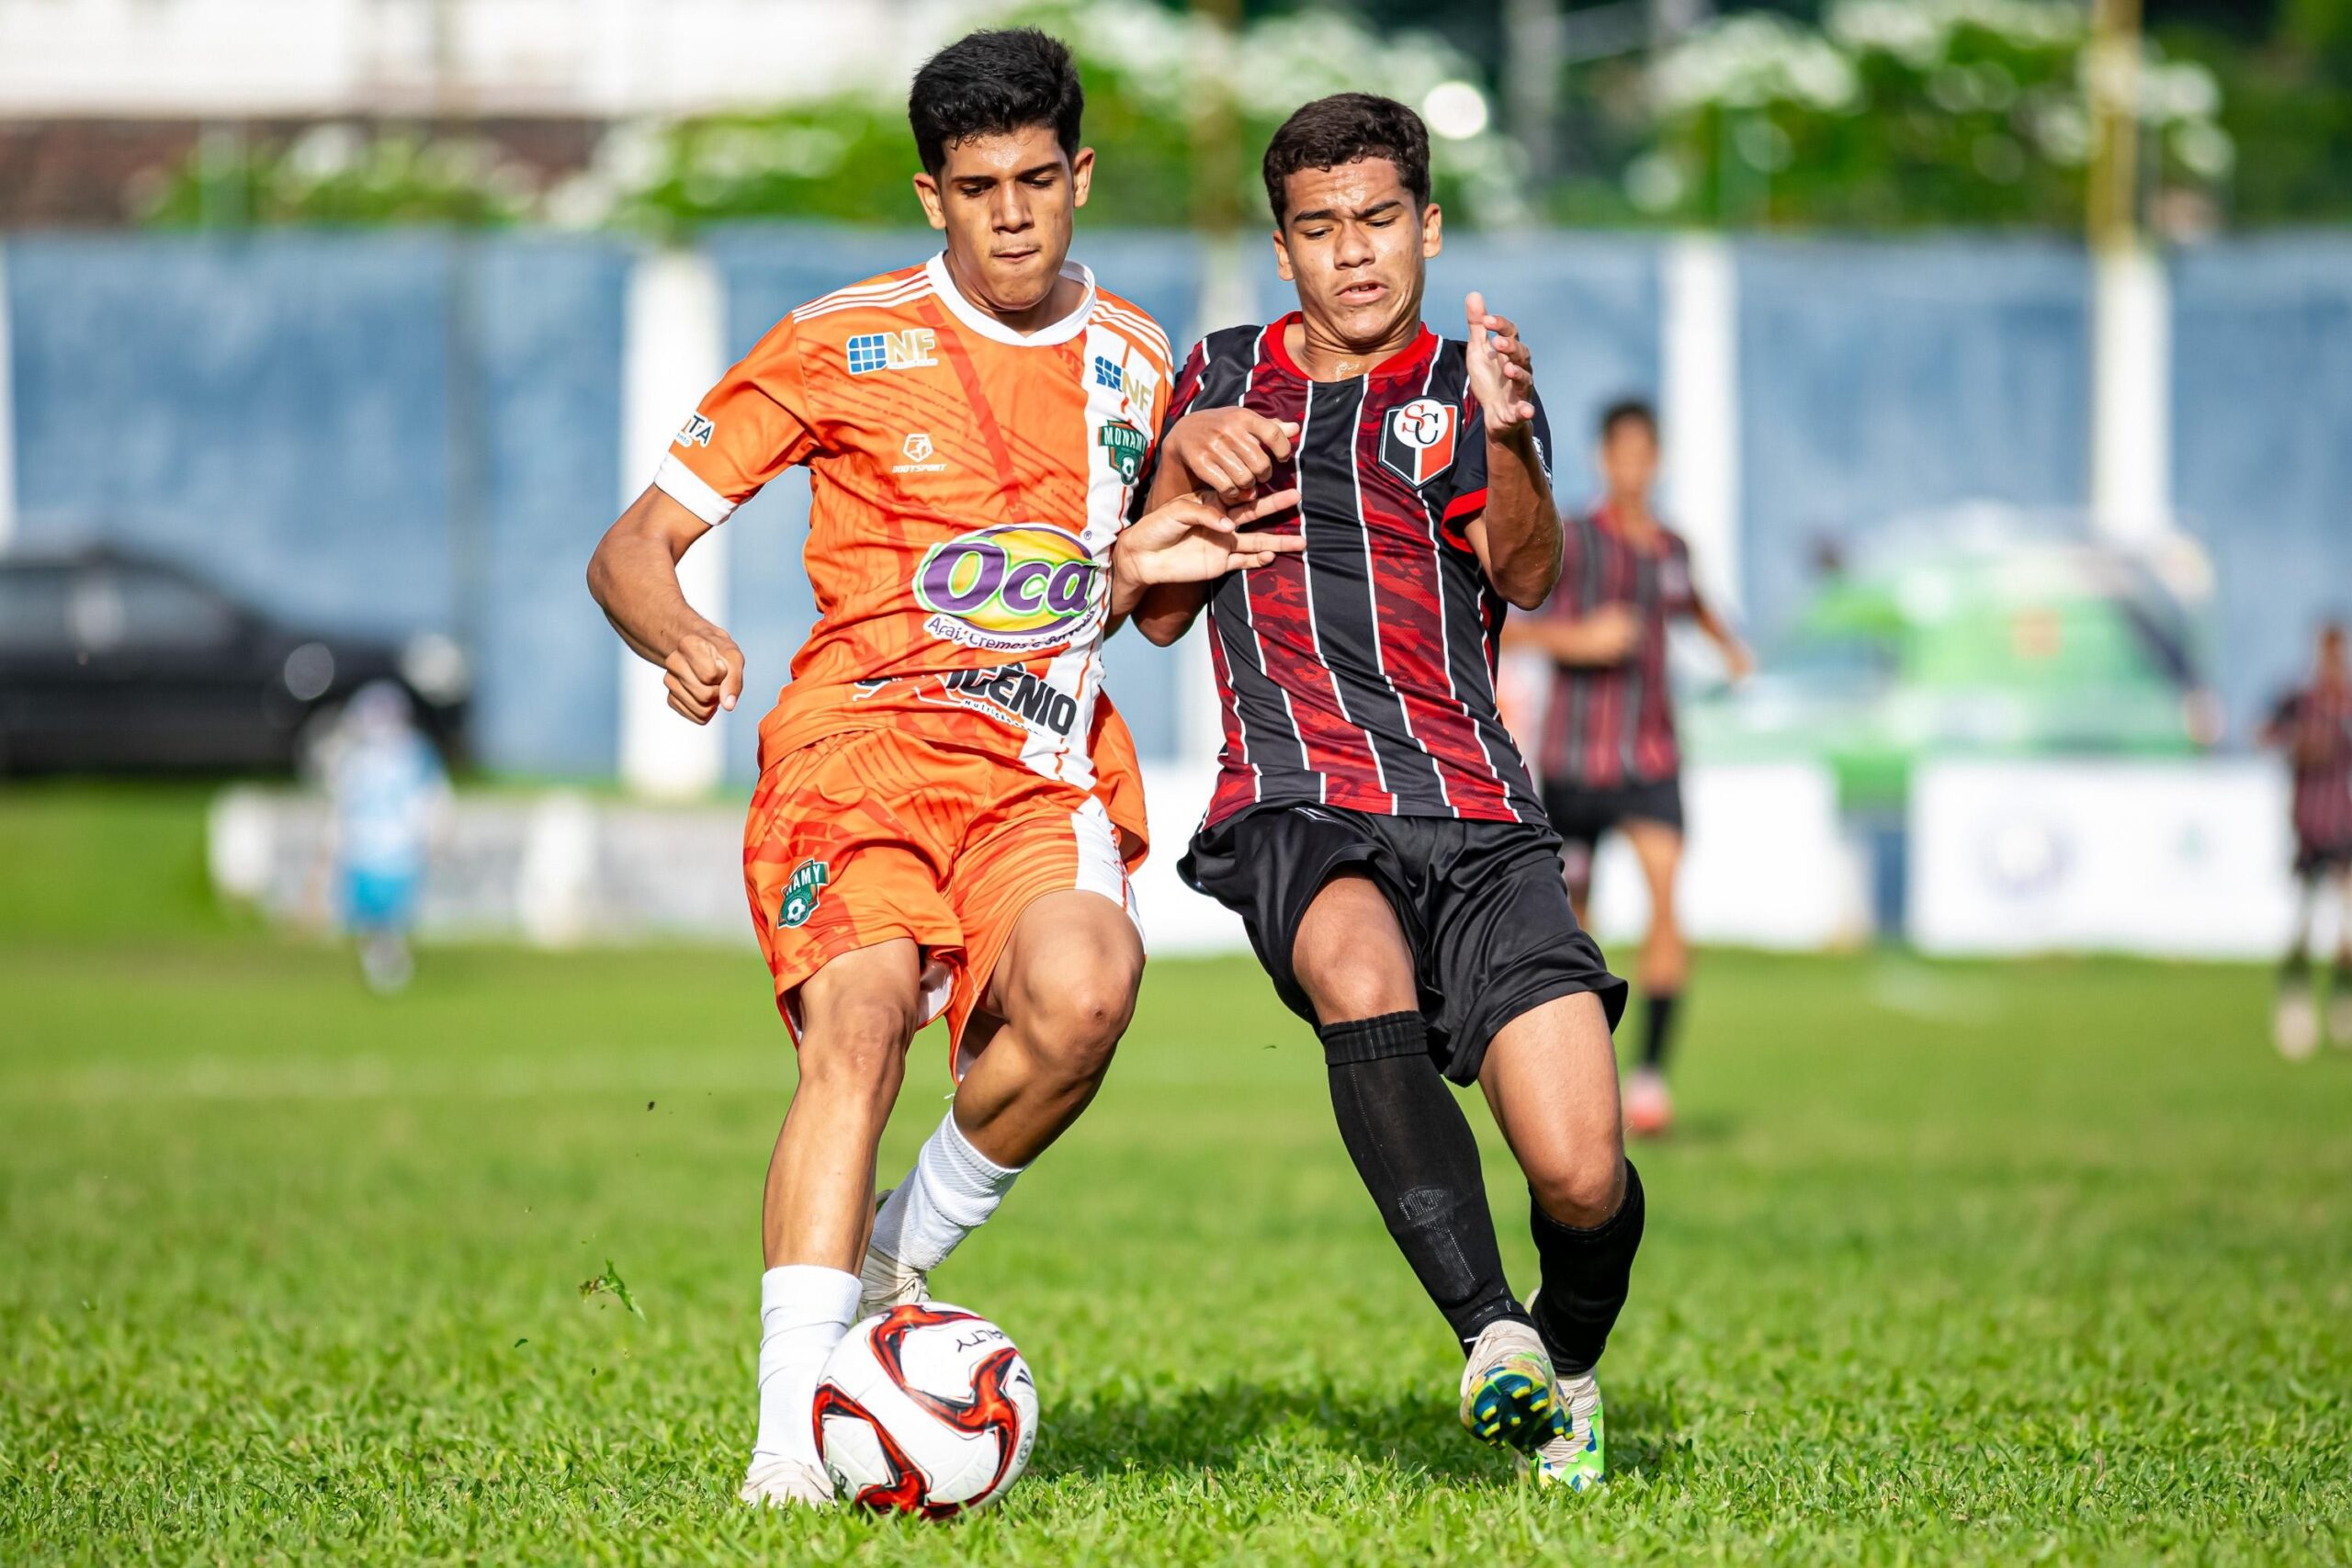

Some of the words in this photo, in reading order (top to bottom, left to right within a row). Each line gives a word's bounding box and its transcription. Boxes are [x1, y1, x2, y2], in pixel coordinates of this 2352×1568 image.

[887, 331, 933, 364] NF
[1123, 370, 1151, 412] NF
[1401, 403, 1439, 445] SC
[922, 542, 1099, 613] Oca
[968, 630, 1031, 650] Cremes
